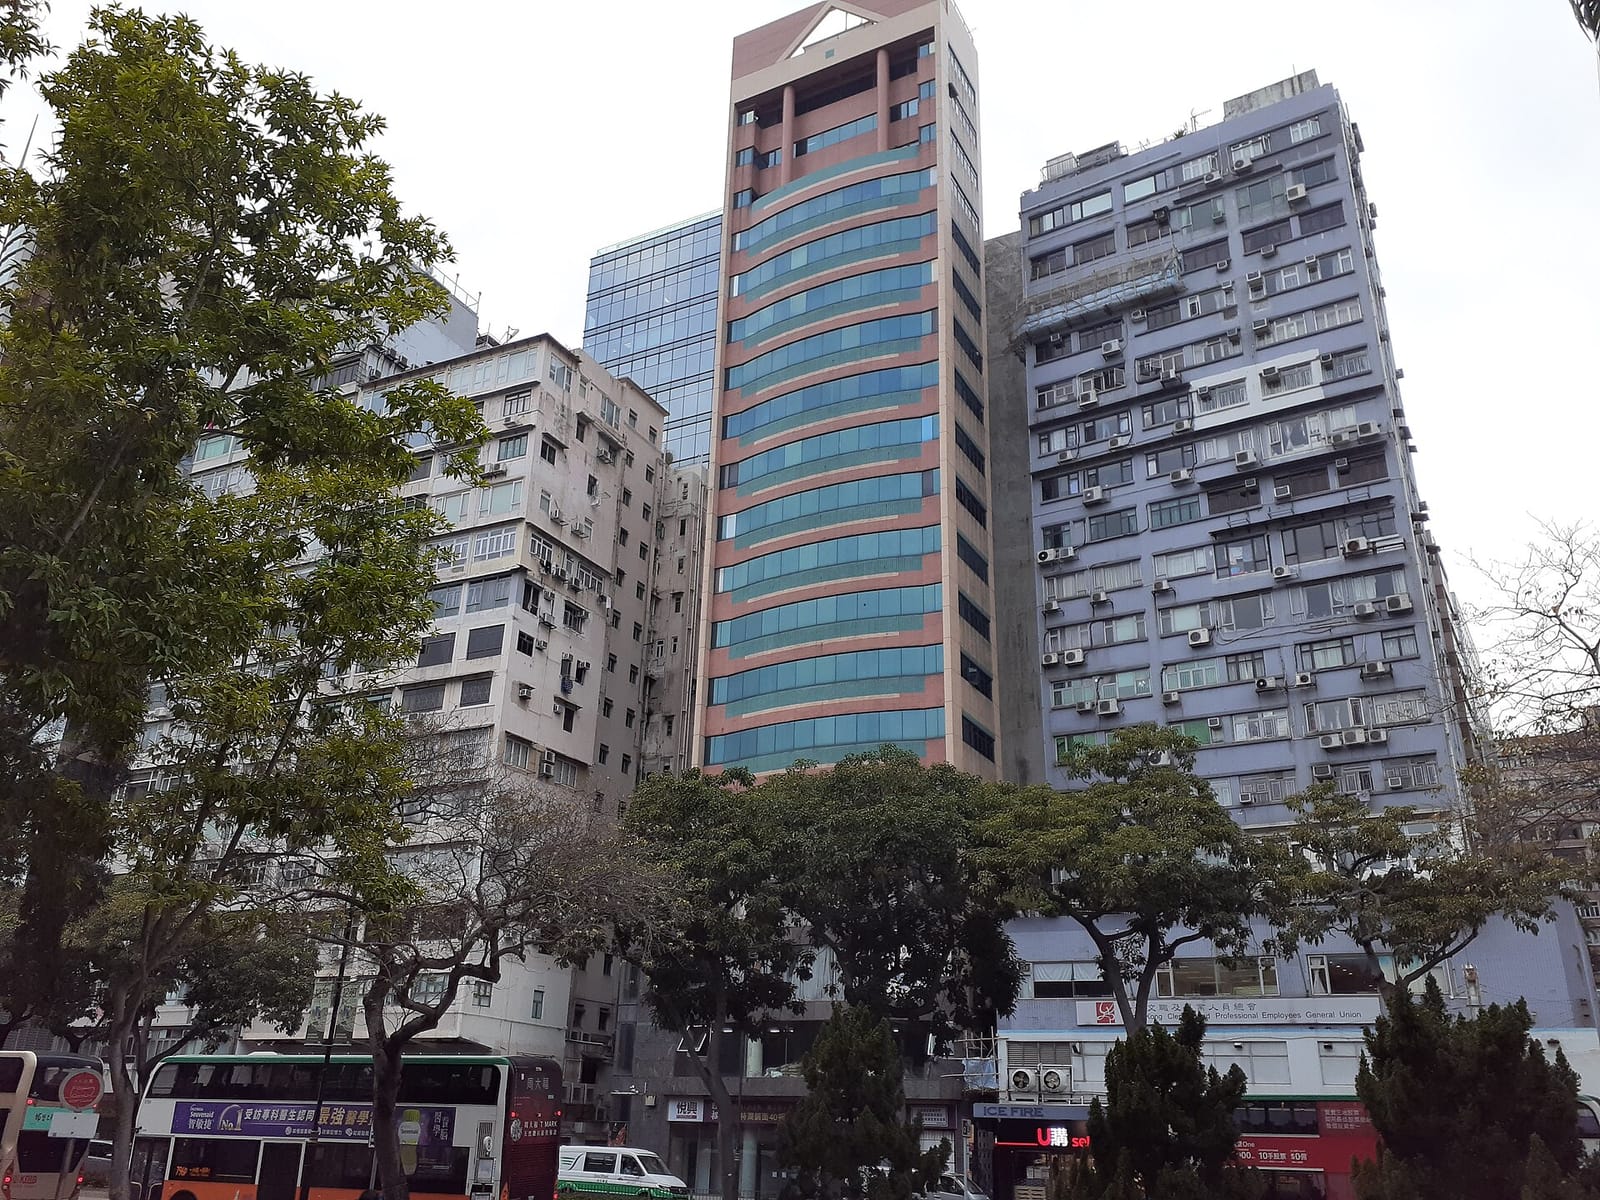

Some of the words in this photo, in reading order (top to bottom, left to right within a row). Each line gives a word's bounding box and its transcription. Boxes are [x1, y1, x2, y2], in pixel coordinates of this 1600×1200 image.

[1215, 1012, 1259, 1020] Professional
[1261, 1011, 1302, 1021] Employees
[1305, 1011, 1336, 1019] General
[1339, 1010, 1362, 1018] Union
[1010, 1107, 1044, 1118] FIRE
